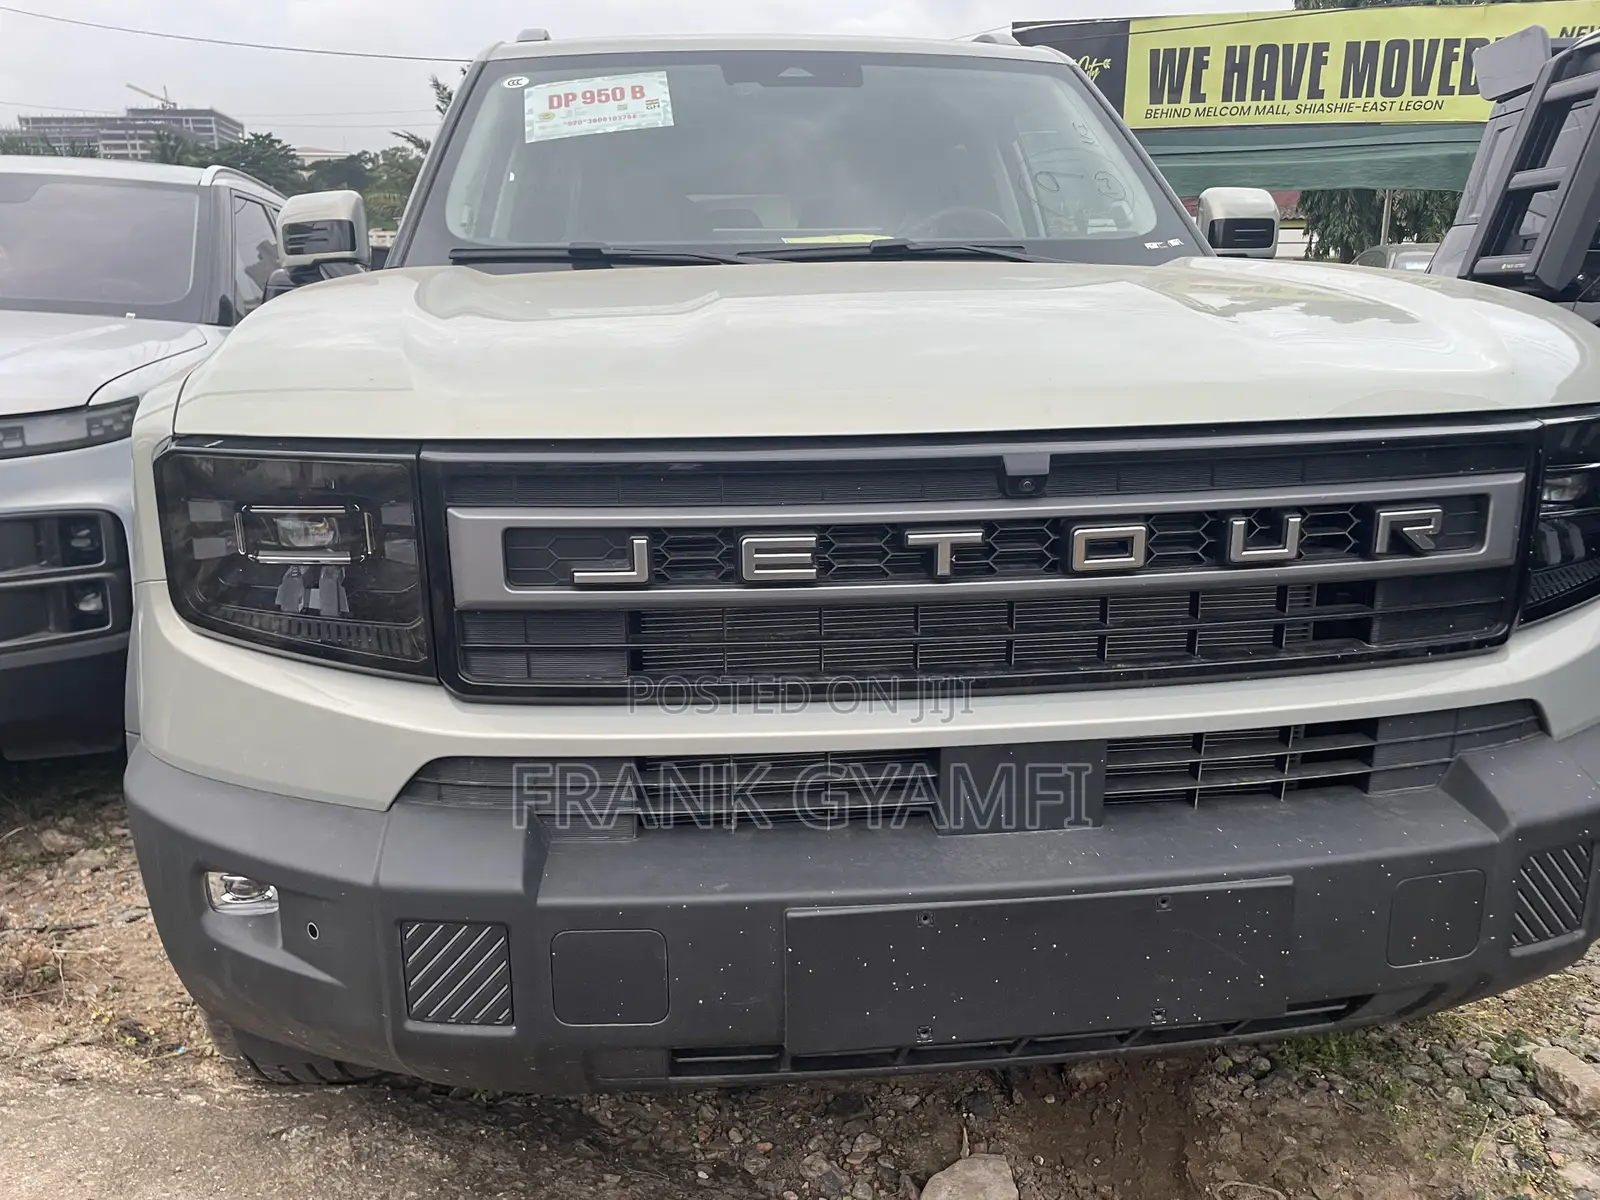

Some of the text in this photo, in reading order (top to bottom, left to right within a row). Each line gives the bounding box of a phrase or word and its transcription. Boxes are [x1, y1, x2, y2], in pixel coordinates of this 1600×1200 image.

[1149, 37, 1505, 105] WE HAVE MOVED
[548, 85, 646, 110] DP 950 B
[1144, 99, 1444, 119] BEHIND MELCOM MALL, SHIASHIE-EAST LEGON
[571, 504, 1443, 585] JETOUR
